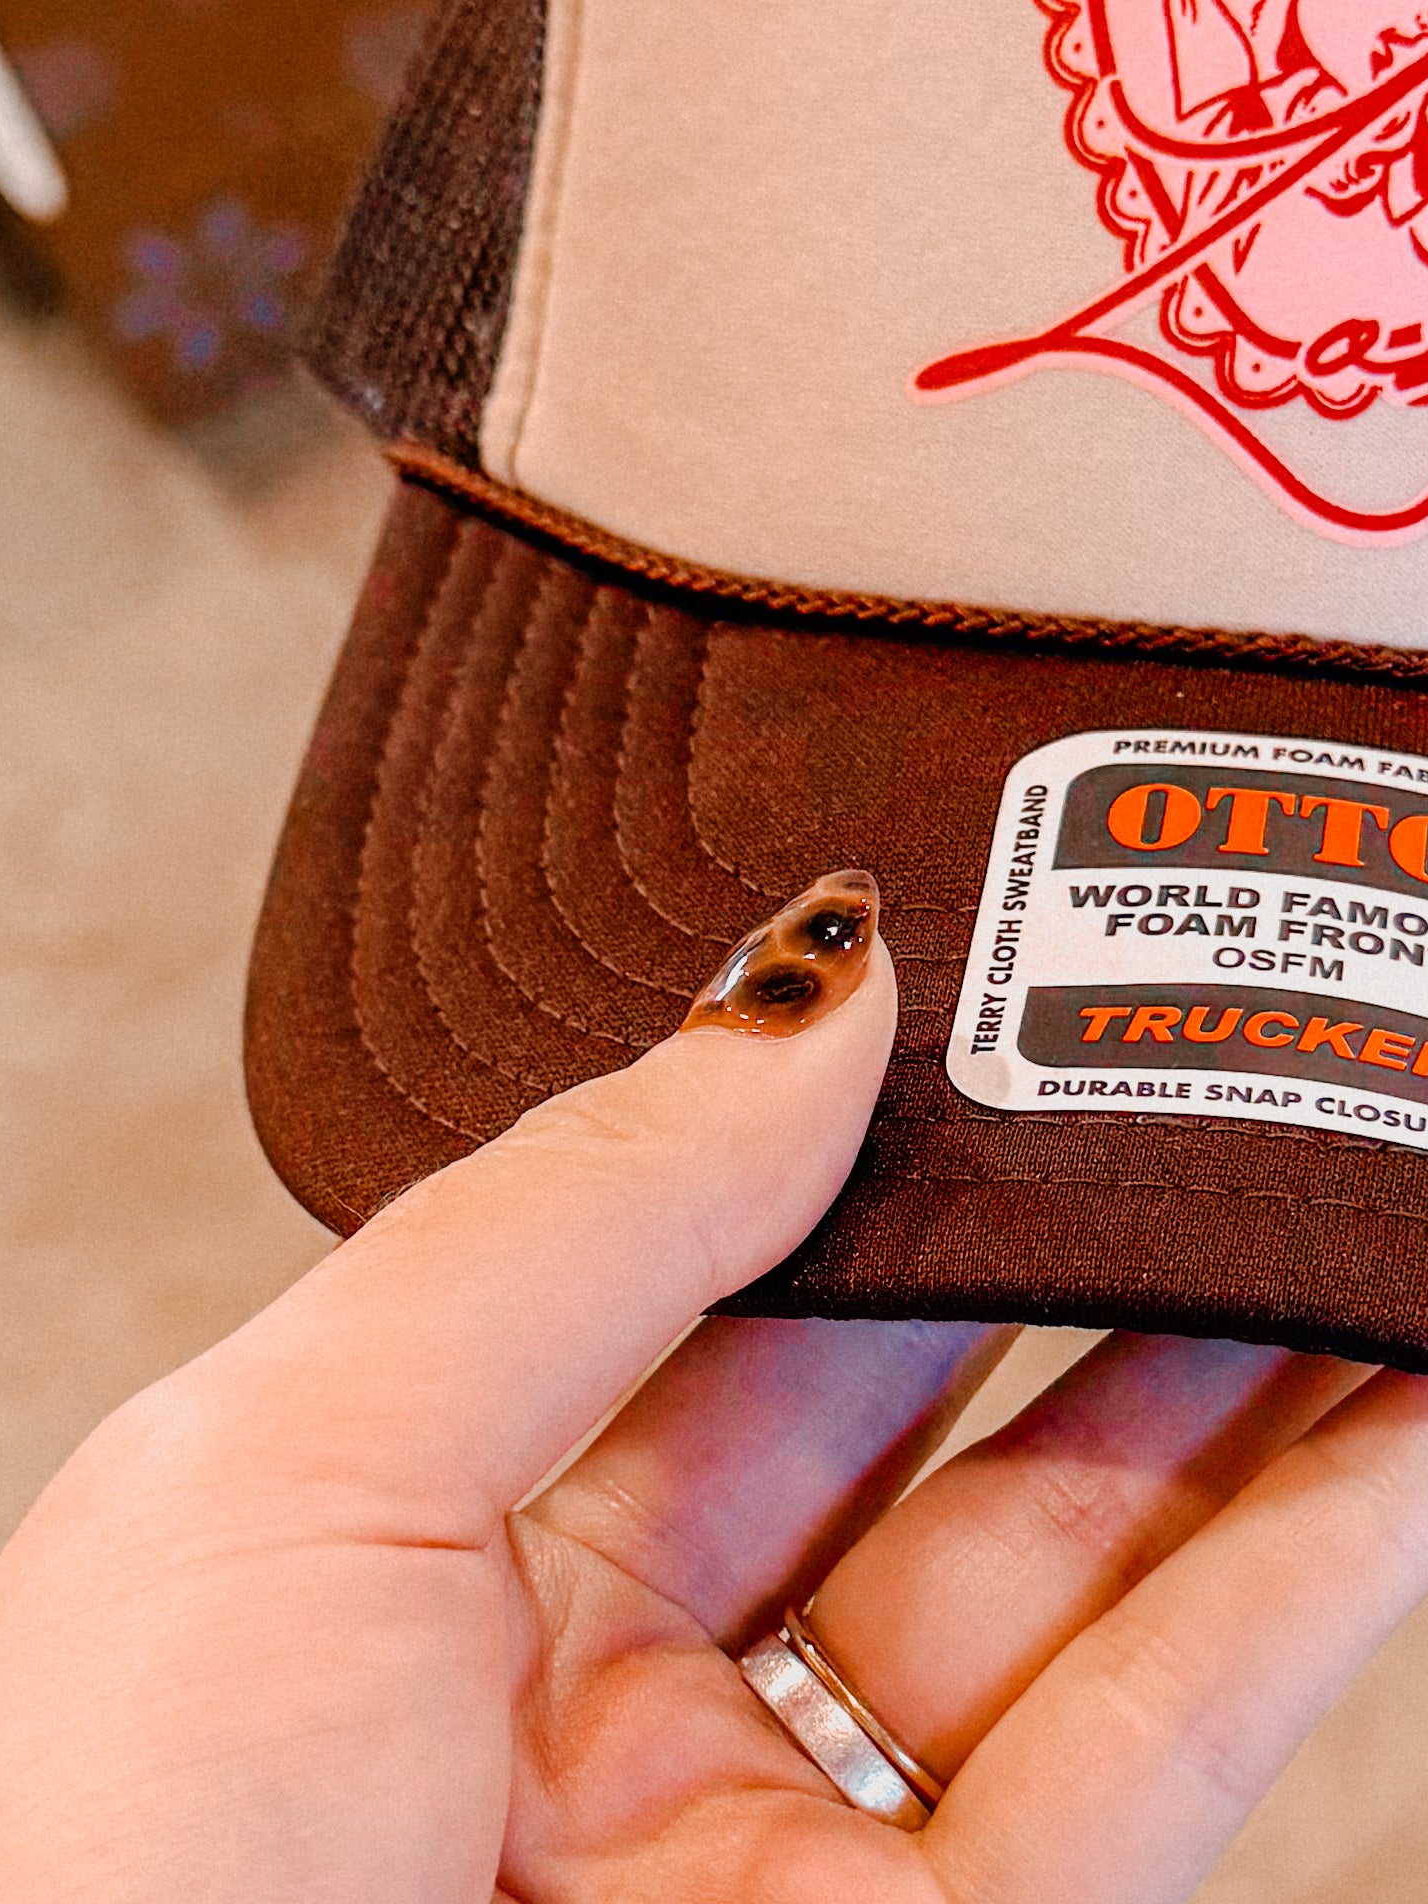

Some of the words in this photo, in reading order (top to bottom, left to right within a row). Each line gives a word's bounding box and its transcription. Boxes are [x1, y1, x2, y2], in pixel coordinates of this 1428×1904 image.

[1113, 740, 1259, 760] PREMIUM
[1272, 747, 1365, 772] FOAM
[1002, 784, 1049, 911] SWEATBAND
[1069, 884, 1261, 910] WORLD
[1104, 912, 1258, 939] FOAM
[987, 919, 1023, 985] CLOTH
[1211, 946, 1345, 982] OSFM
[971, 992, 1007, 1055] TERRY
[1036, 1079, 1193, 1099] DURABLE
[1205, 1083, 1303, 1109] SNAP
